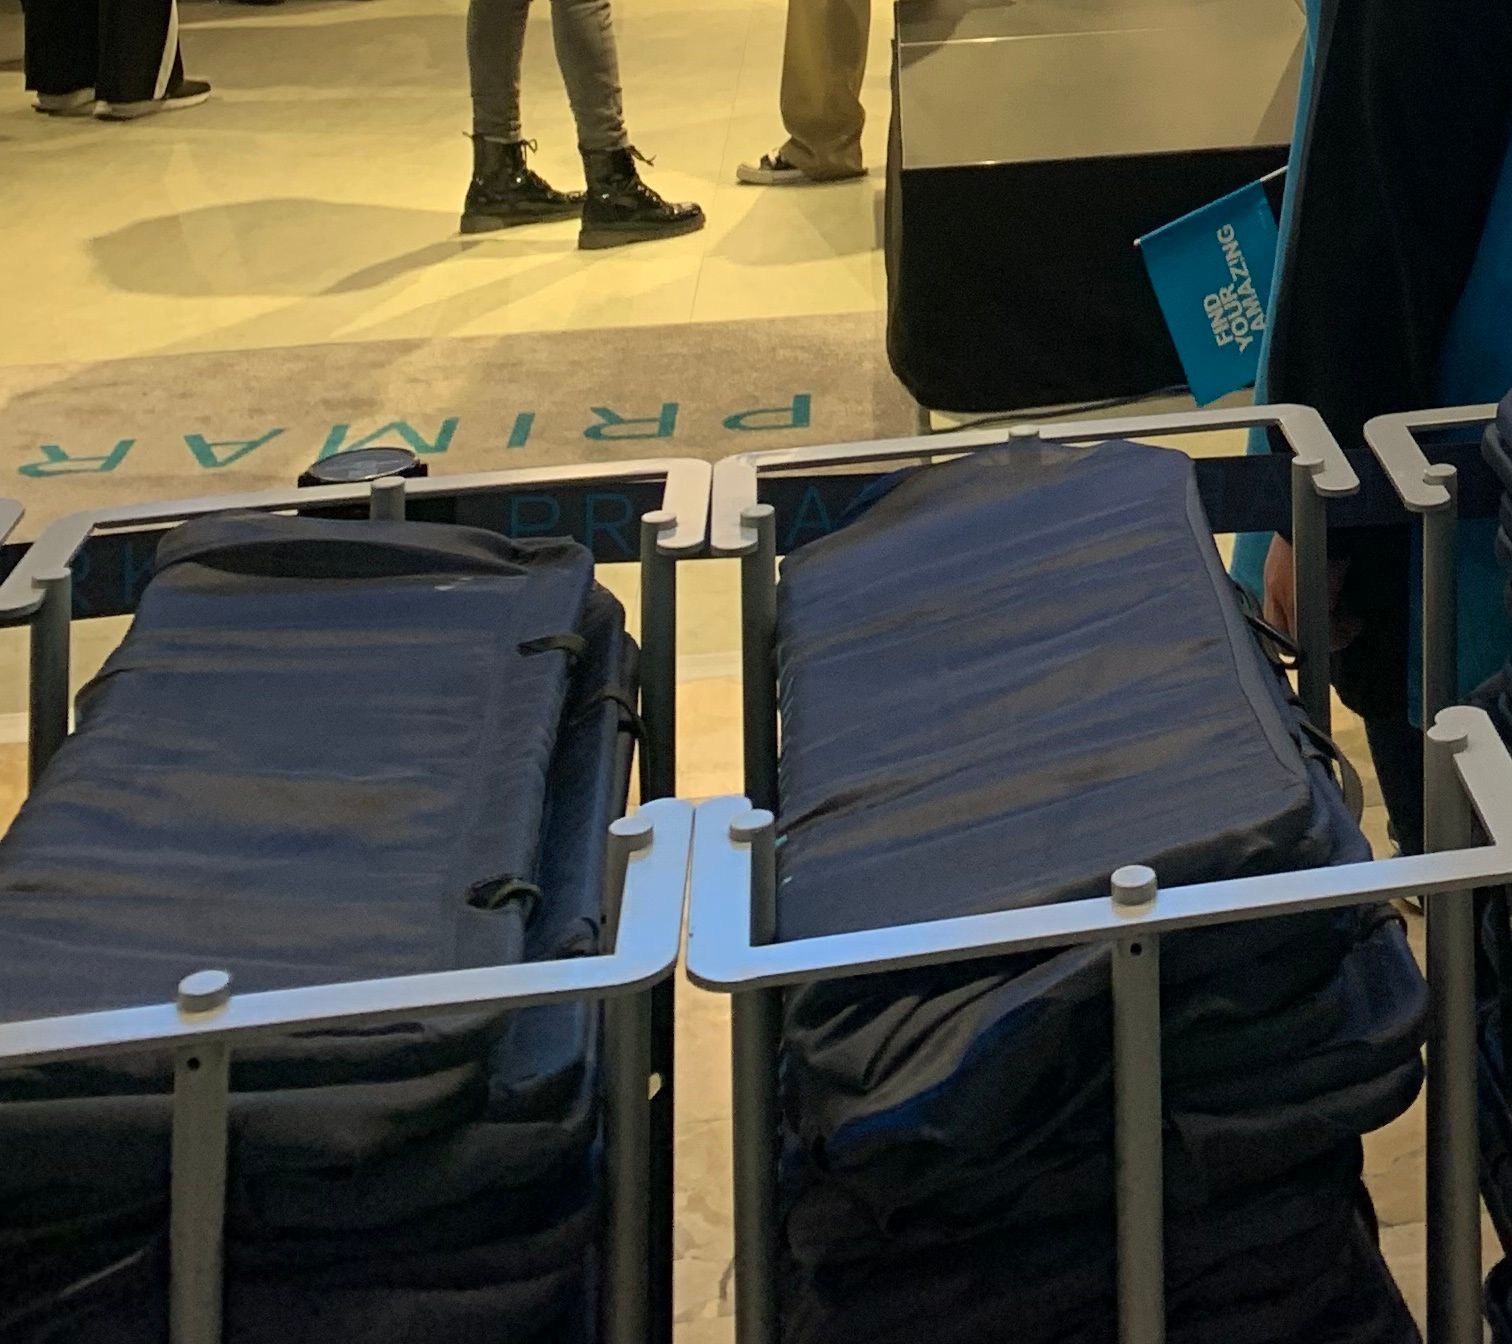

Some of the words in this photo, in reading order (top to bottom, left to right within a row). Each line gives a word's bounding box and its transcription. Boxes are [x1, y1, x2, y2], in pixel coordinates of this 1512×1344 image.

[1216, 223, 1265, 331] AMAZING
[1203, 293, 1235, 347] FIND
[1218, 282, 1254, 354] YOUR
